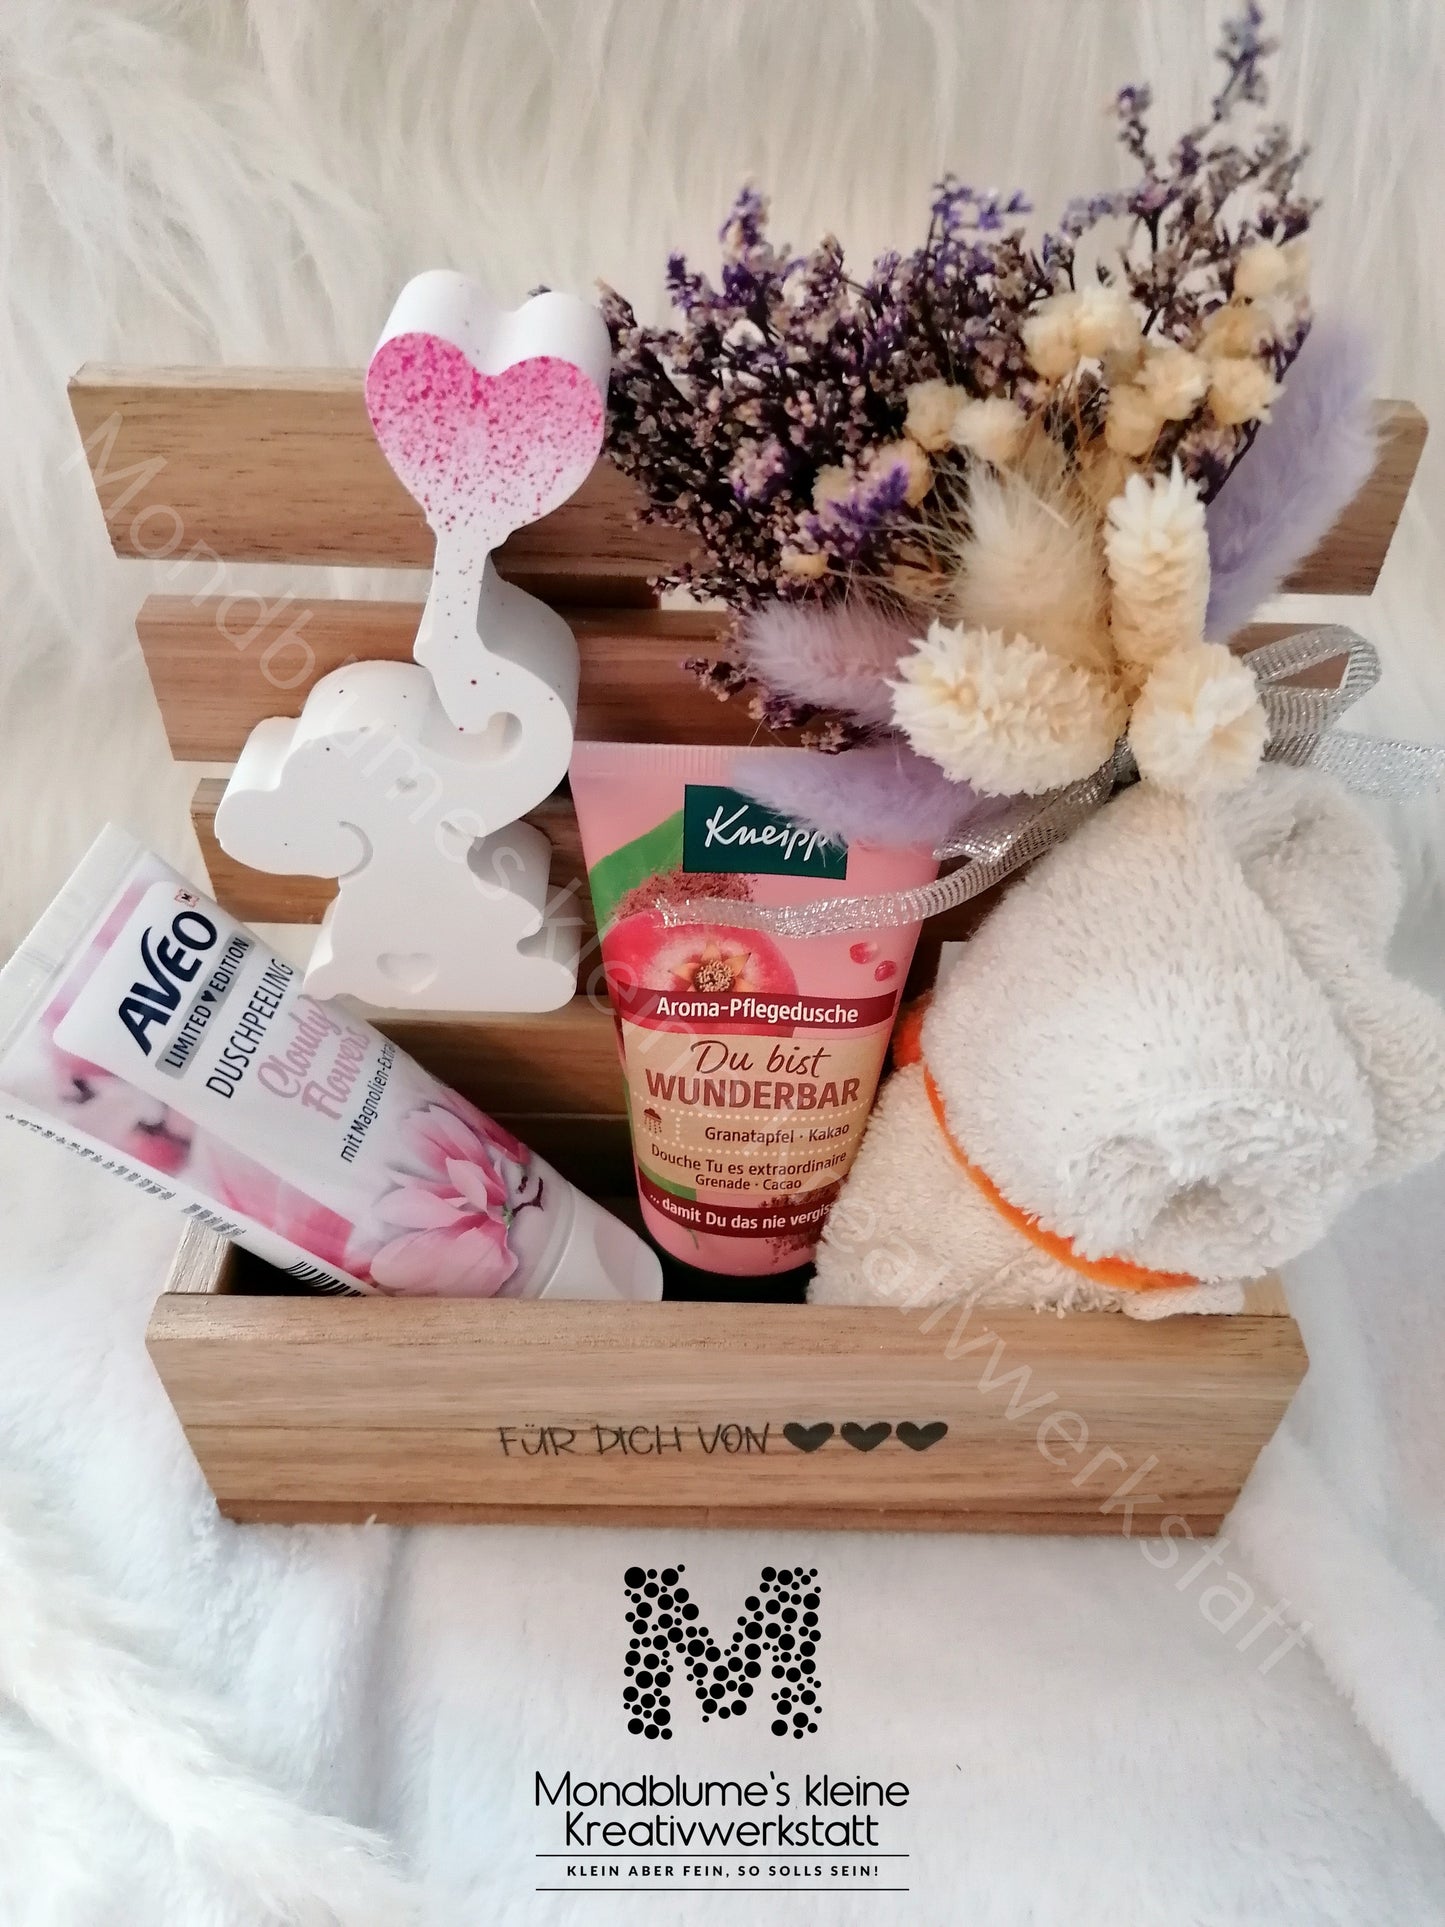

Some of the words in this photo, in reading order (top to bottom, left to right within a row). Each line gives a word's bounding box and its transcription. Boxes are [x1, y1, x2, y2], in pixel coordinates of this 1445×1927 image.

[704, 804, 829, 861] Kneipp
[118, 911, 218, 1057] AVEO
[165, 1005, 212, 1069] LIMITED
[211, 937, 250, 993] EDITION
[206, 958, 294, 1099] DUSCHPEELING
[656, 996, 859, 1024] Aroma-Pflegedusche
[257, 994, 342, 1098] Cloudy
[690, 1040, 753, 1073] Du
[766, 1044, 831, 1078] bist
[302, 1026, 371, 1121] Flowers
[645, 1069, 860, 1110] WUNDERBAR
[340, 1134, 362, 1163] mit
[705, 1127, 794, 1145] Granatapfel
[808, 1123, 850, 1142] Kakao
[651, 1143, 701, 1171] Douche
[706, 1159, 722, 1173] Tu
[728, 1164, 744, 1175] es
[749, 1151, 847, 1176] extraordinaire
[695, 1174, 750, 1190] Grenade
[763, 1178, 802, 1191] Cacao
[706, 1212, 727, 1227] Du
[731, 1213, 758, 1229] das
[763, 1212, 786, 1229] nie
[496, 1423, 578, 1457] FÜR
[595, 1422, 683, 1456] DICH
[698, 1422, 771, 1456] VON
